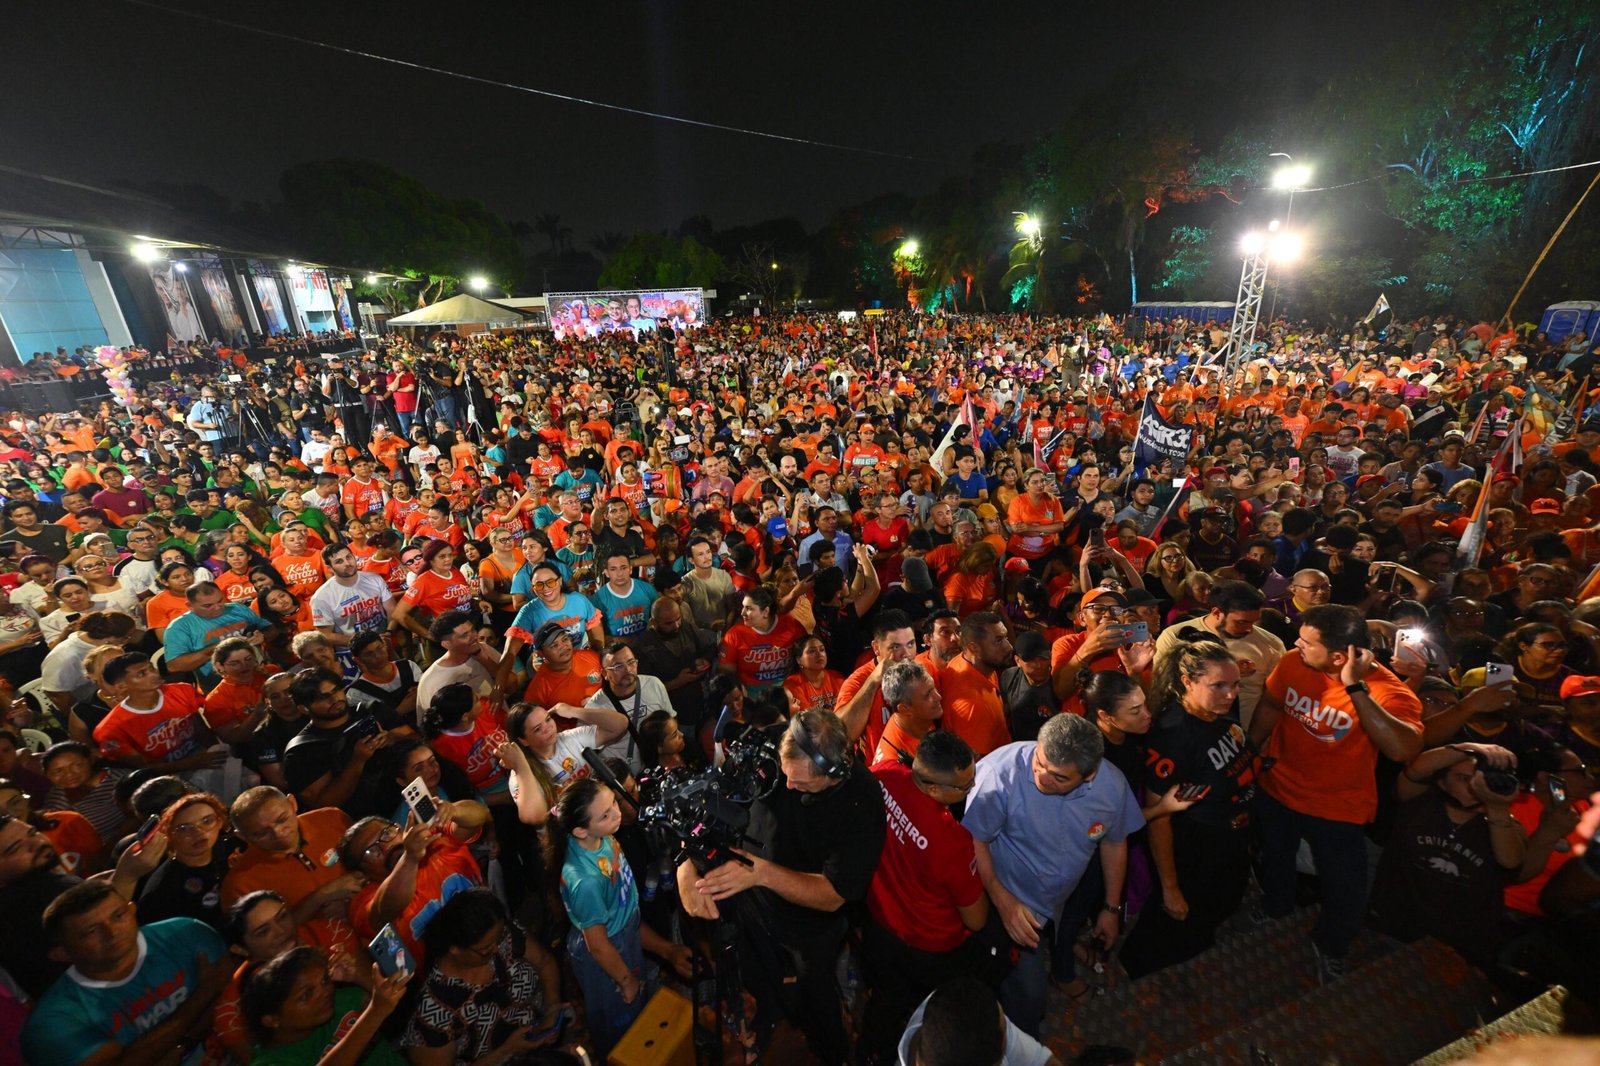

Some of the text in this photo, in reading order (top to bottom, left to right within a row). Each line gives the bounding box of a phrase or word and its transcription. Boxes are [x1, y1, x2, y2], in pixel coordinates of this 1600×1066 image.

[341, 596, 379, 618] Júnior
[623, 612, 645, 624] MAR
[616, 621, 645, 635] 70222
[1285, 687, 1354, 730] DAVID
[1145, 748, 1175, 779] 70
